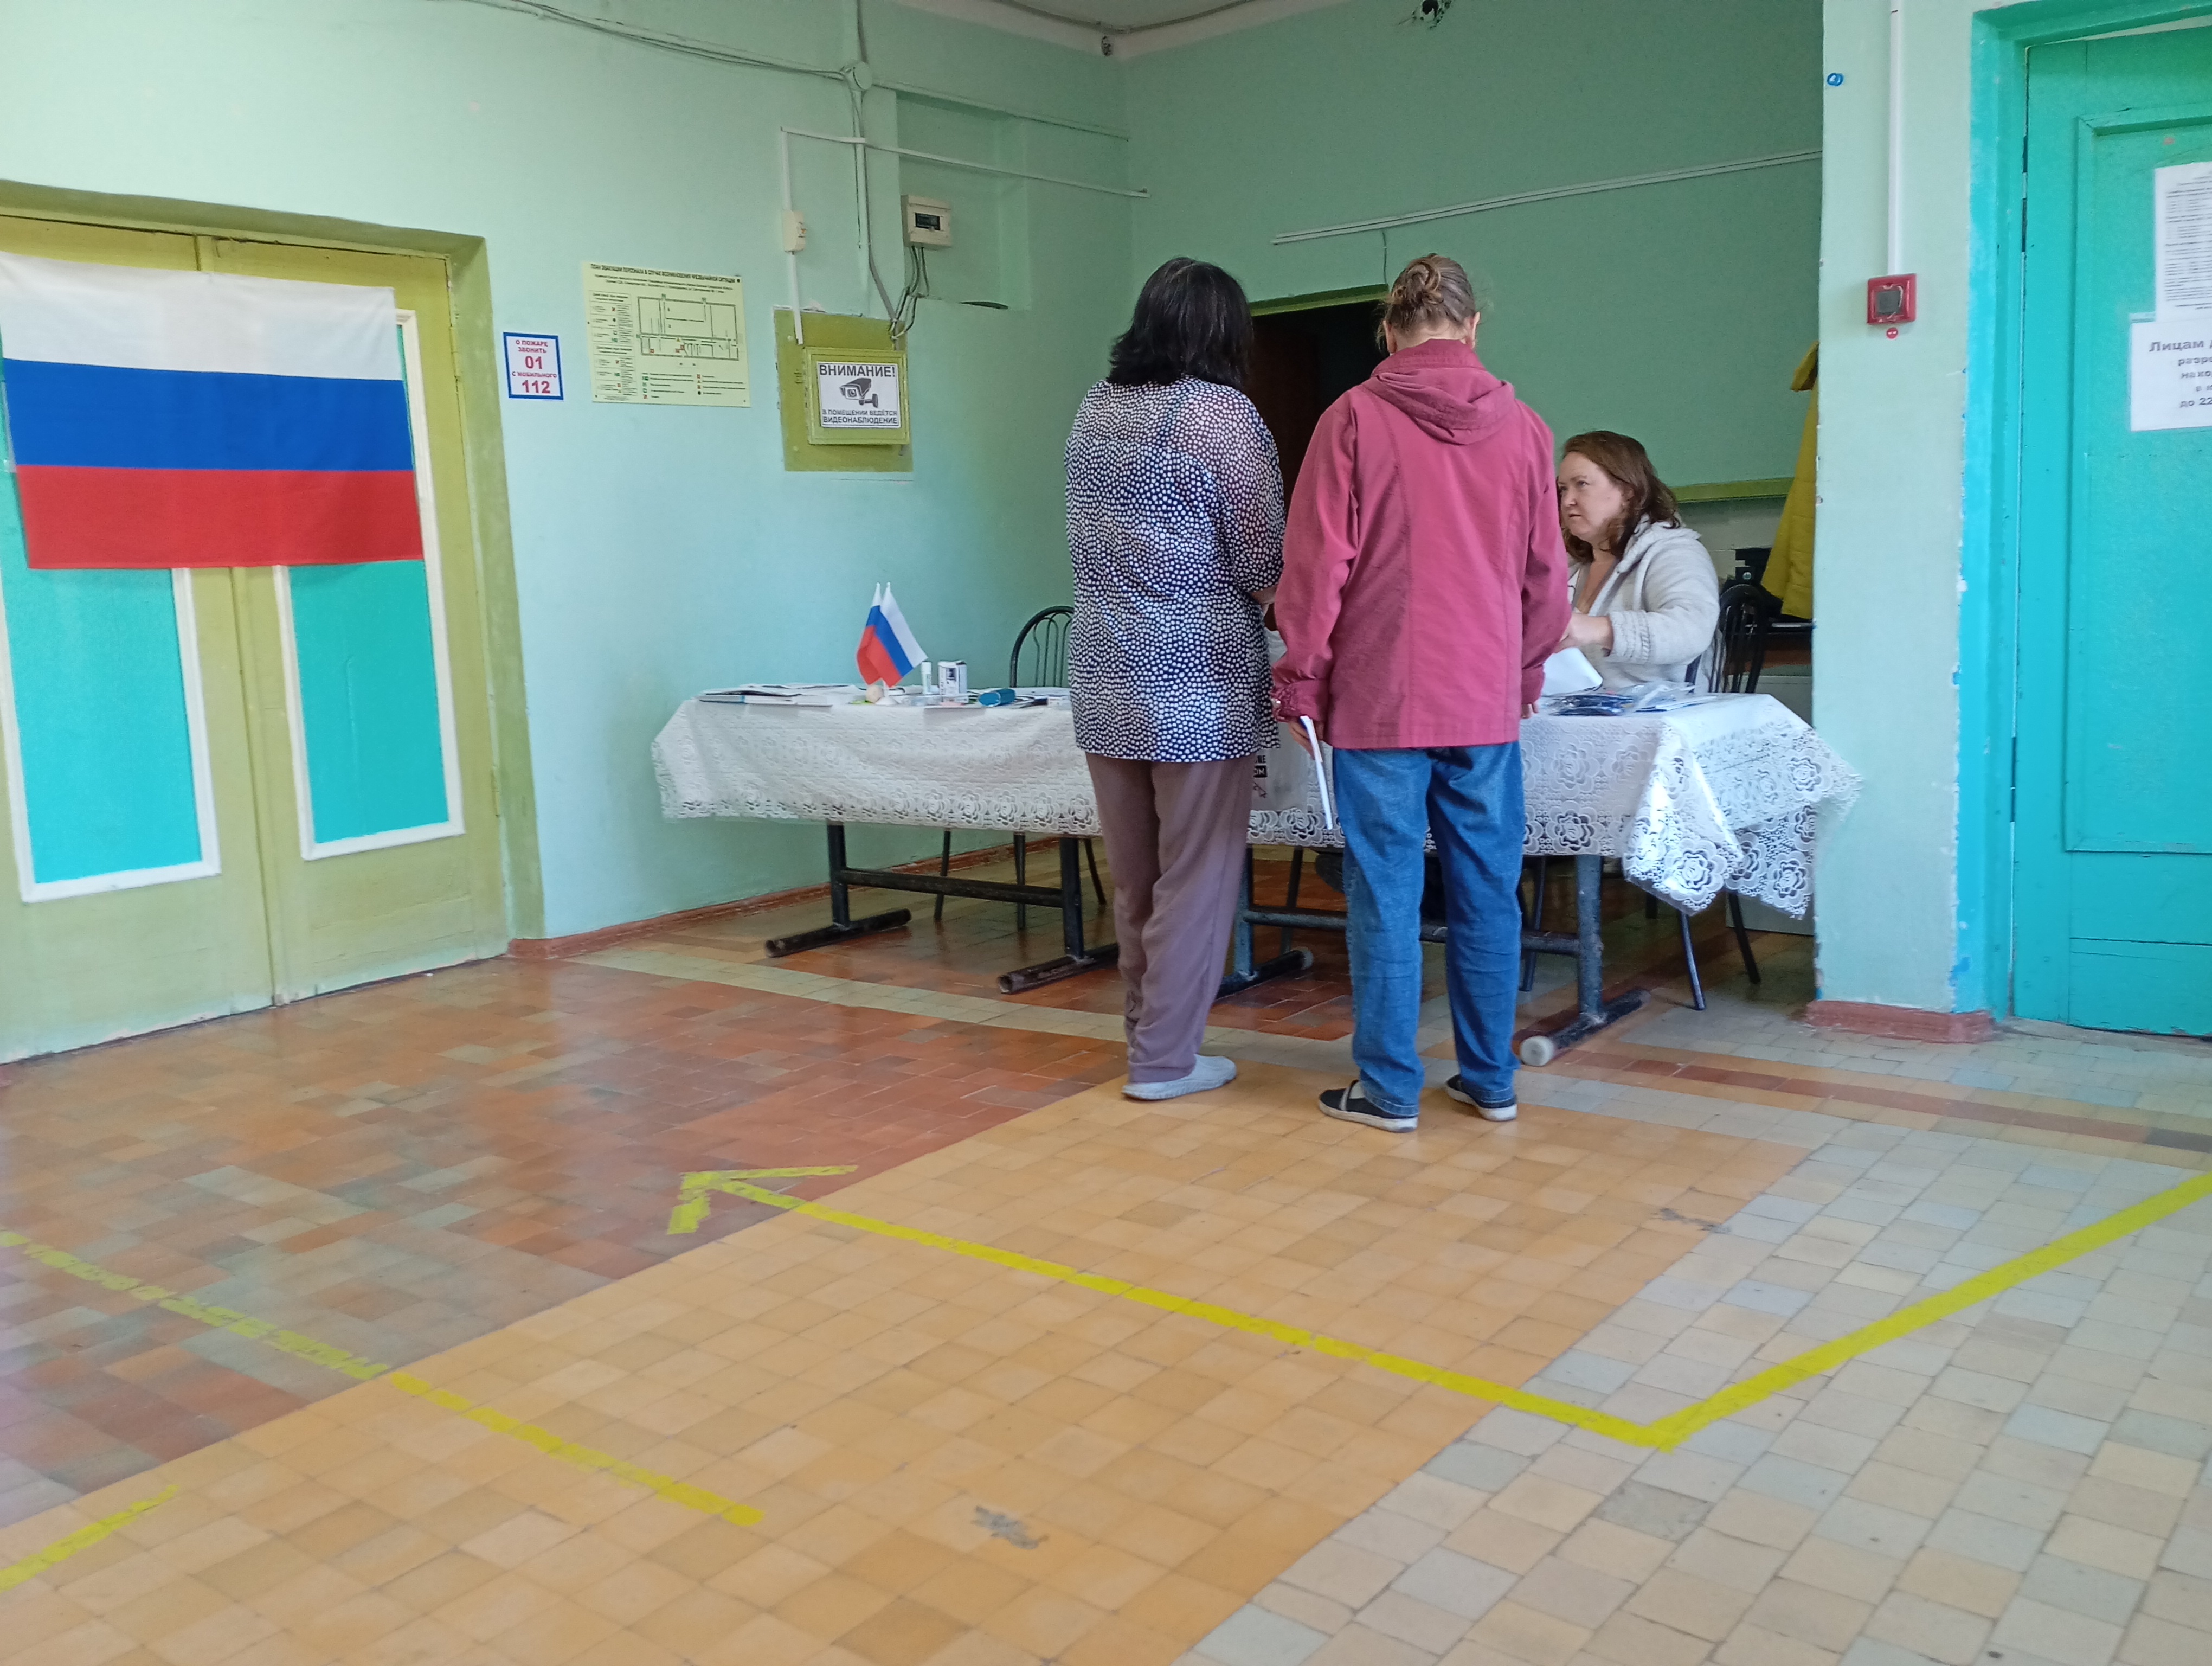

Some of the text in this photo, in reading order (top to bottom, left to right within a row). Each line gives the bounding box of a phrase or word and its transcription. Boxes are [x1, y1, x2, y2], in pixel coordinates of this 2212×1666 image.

[2149, 341, 2204, 351] Лицам
[525, 356, 542, 369] 01
[819, 364, 895, 377] ВНИМАНИЕ!
[522, 380, 551, 394] 112
